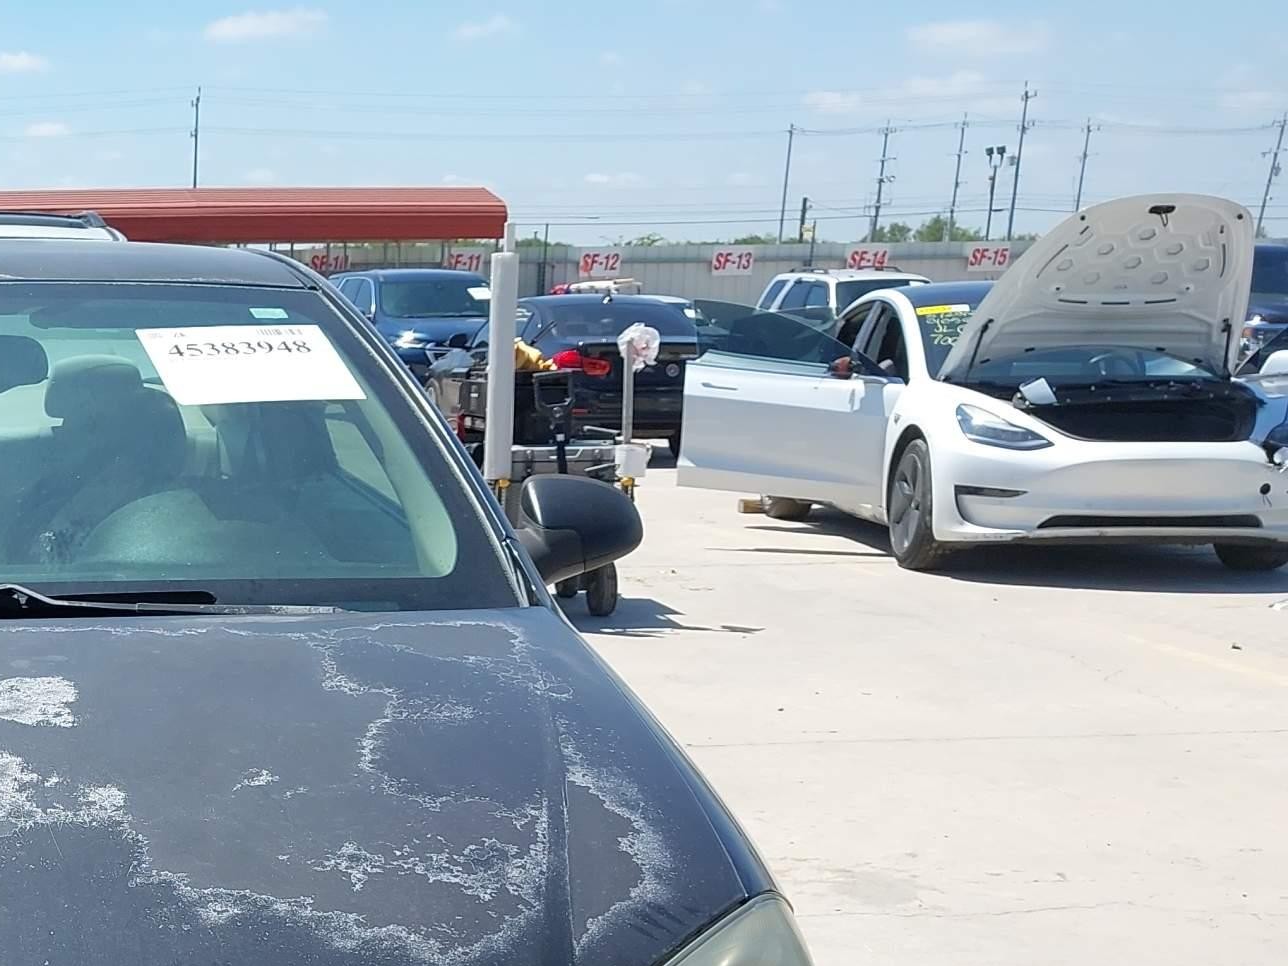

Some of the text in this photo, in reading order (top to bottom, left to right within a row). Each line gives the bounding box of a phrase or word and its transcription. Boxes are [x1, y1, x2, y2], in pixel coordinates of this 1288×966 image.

[583, 253, 620, 271] SF-12
[714, 252, 752, 270] SF-13
[848, 250, 888, 269] SF-14
[969, 248, 1009, 266] SF-15
[168, 340, 312, 357] 45383948
